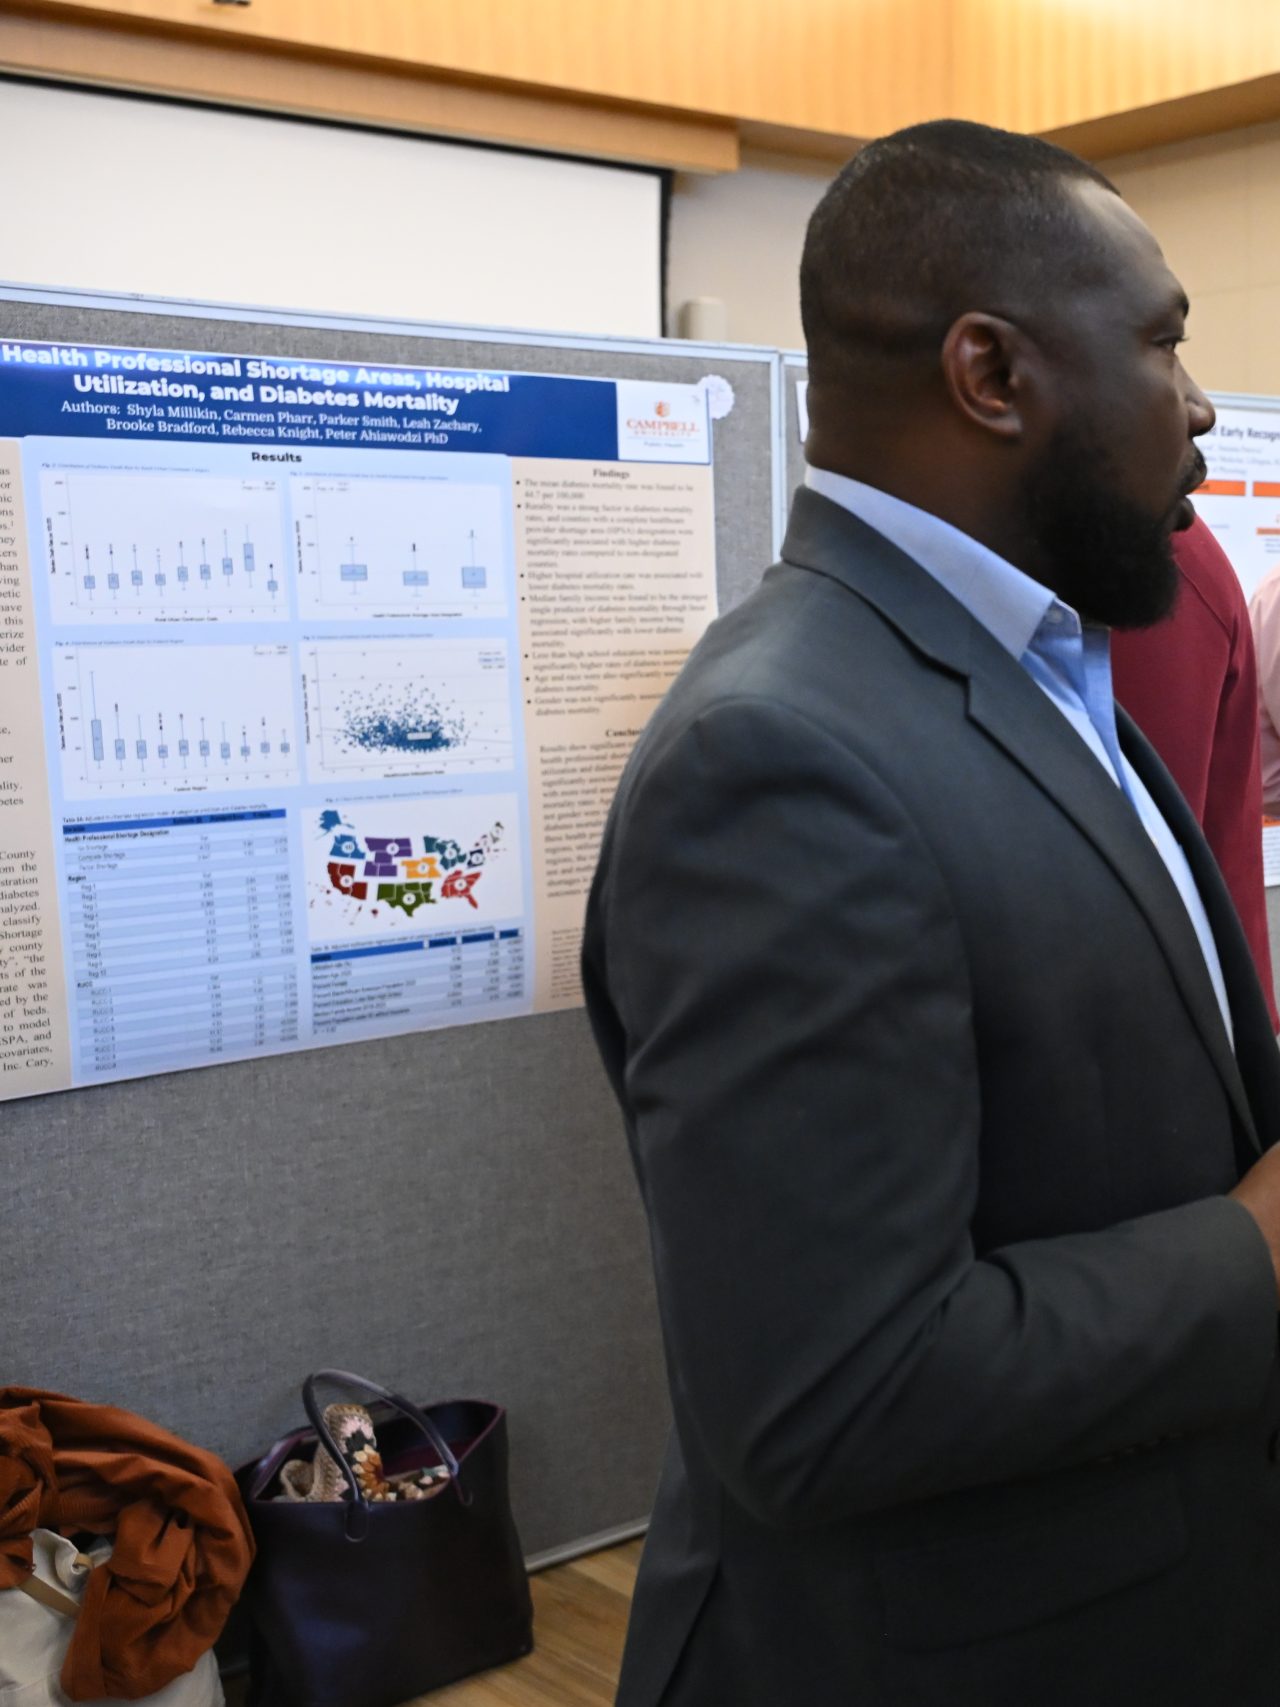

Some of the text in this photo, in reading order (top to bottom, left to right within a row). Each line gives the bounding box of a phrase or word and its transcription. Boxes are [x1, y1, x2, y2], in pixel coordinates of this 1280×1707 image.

[1, 344, 510, 393] Health Professional Shortage Areas, Hospital
[73, 374, 459, 415] Utilization, and Diabetes Mortality
[61, 400, 483, 434] Authors: Shyla Millikin, Carmen Pharr, Parker Smith, Leah Zachary,
[106, 418, 449, 444] Brooke Bradford, Rebecca Knight, Peter Ahiawodzi PhD
[626, 419, 699, 433] CAMPBELL
[1220, 425, 1244, 440] Early
[251, 451, 302, 464] Results
[593, 469, 630, 479] Findings
[5, 616, 24, 625] this
[16, 655, 28, 666] of
[21, 862, 37, 872] the
[3, 915, 41, 926] classify
[9, 942, 43, 953] county
[15, 967, 25, 978] of
[31, 967, 46, 976] the
[16, 995, 28, 1006] by
[33, 993, 48, 1001] the
[4, 1009, 15, 1018] of
[4, 1018, 51, 1032] to model
[34, 1031, 52, 1041] and
